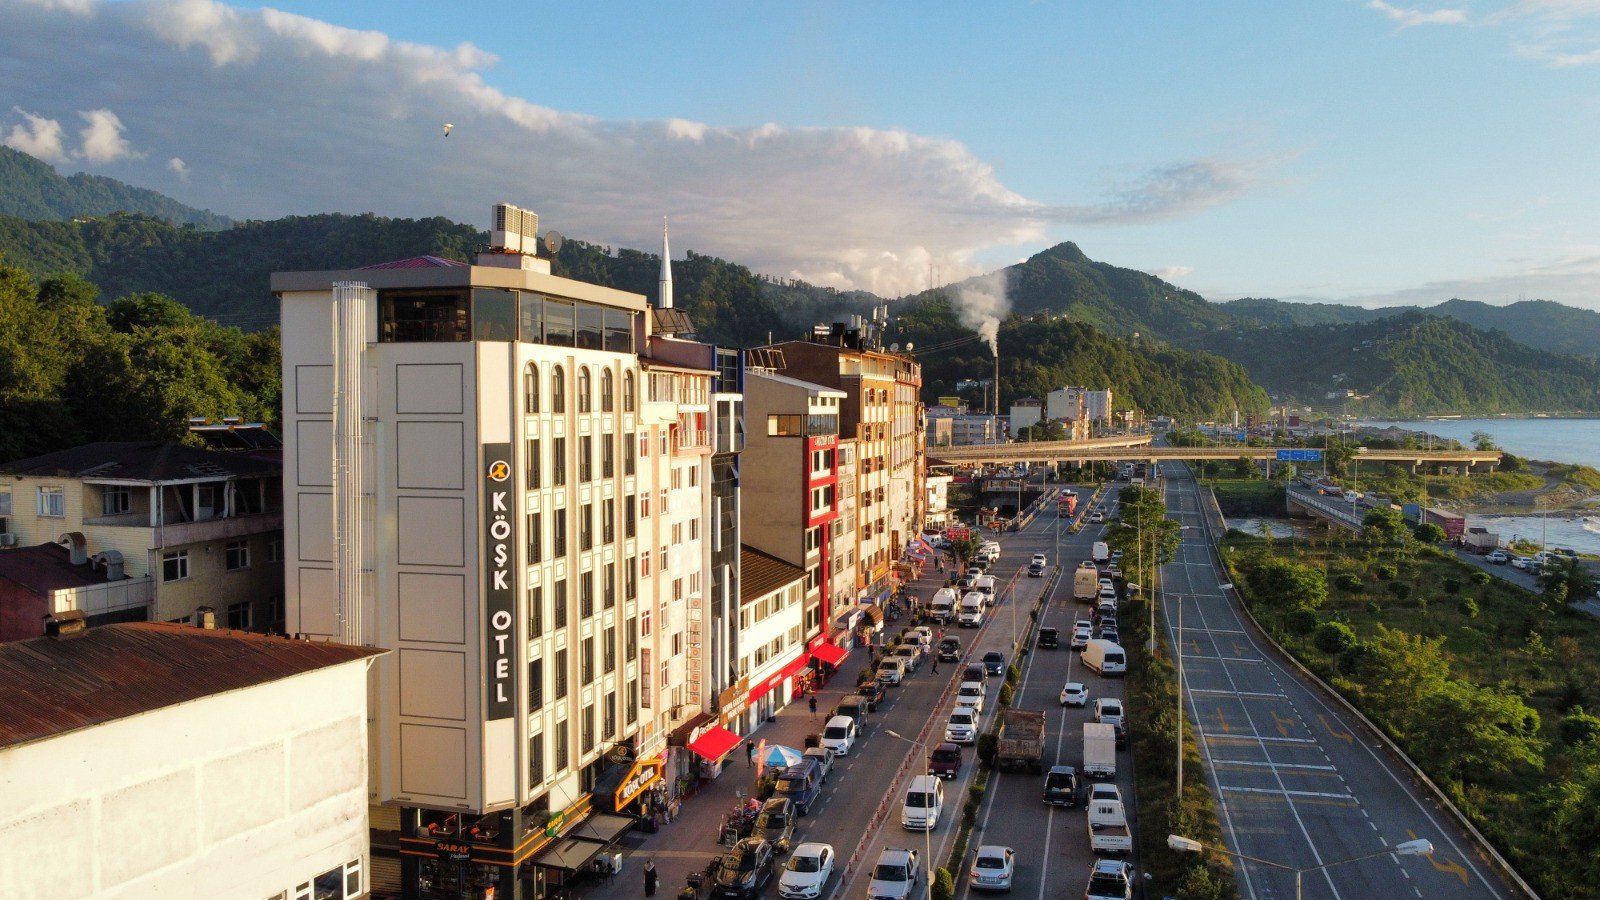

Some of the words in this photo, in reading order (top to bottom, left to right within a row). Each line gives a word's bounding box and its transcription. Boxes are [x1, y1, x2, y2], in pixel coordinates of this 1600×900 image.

[490, 491, 511, 590] KÖŞK
[491, 610, 512, 703] OTEL
[640, 766, 655, 785] OTEL
[437, 843, 470, 854] SARAY
